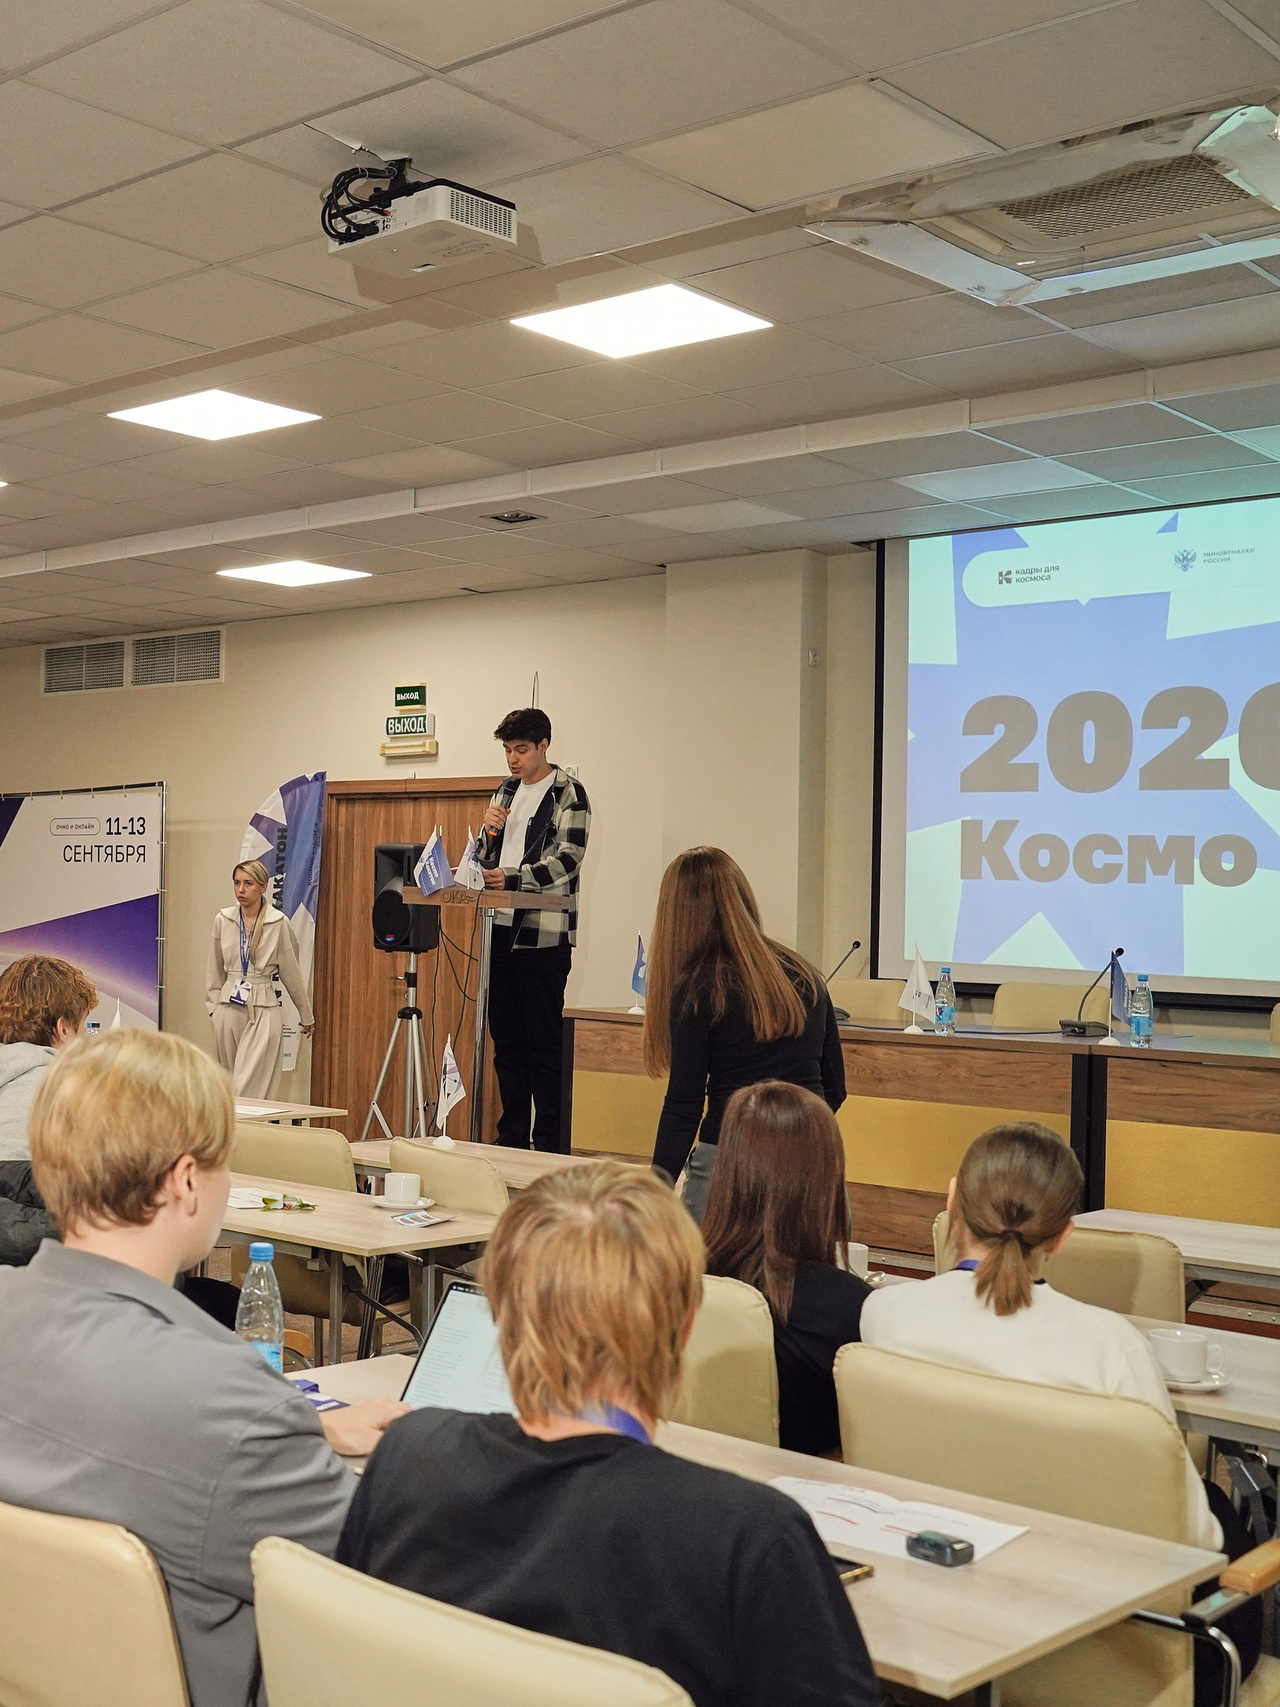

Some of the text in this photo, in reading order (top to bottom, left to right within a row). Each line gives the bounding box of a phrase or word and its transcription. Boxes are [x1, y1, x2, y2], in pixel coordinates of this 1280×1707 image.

[1203, 548, 1255, 558] МИНОБРНАУКИ
[1203, 557, 1231, 565] РОССИИ
[1015, 565, 1060, 576] кадры для
[1015, 574, 1051, 583] космоса
[396, 691, 419, 701] ВЫХОД
[388, 717, 425, 735] ВЫХОД
[74, 822, 95, 830] ОНЛАЙН
[105, 816, 146, 836] 11-13
[63, 844, 146, 863] СЕНТЯБРЯ
[960, 819, 1258, 888] Космо
